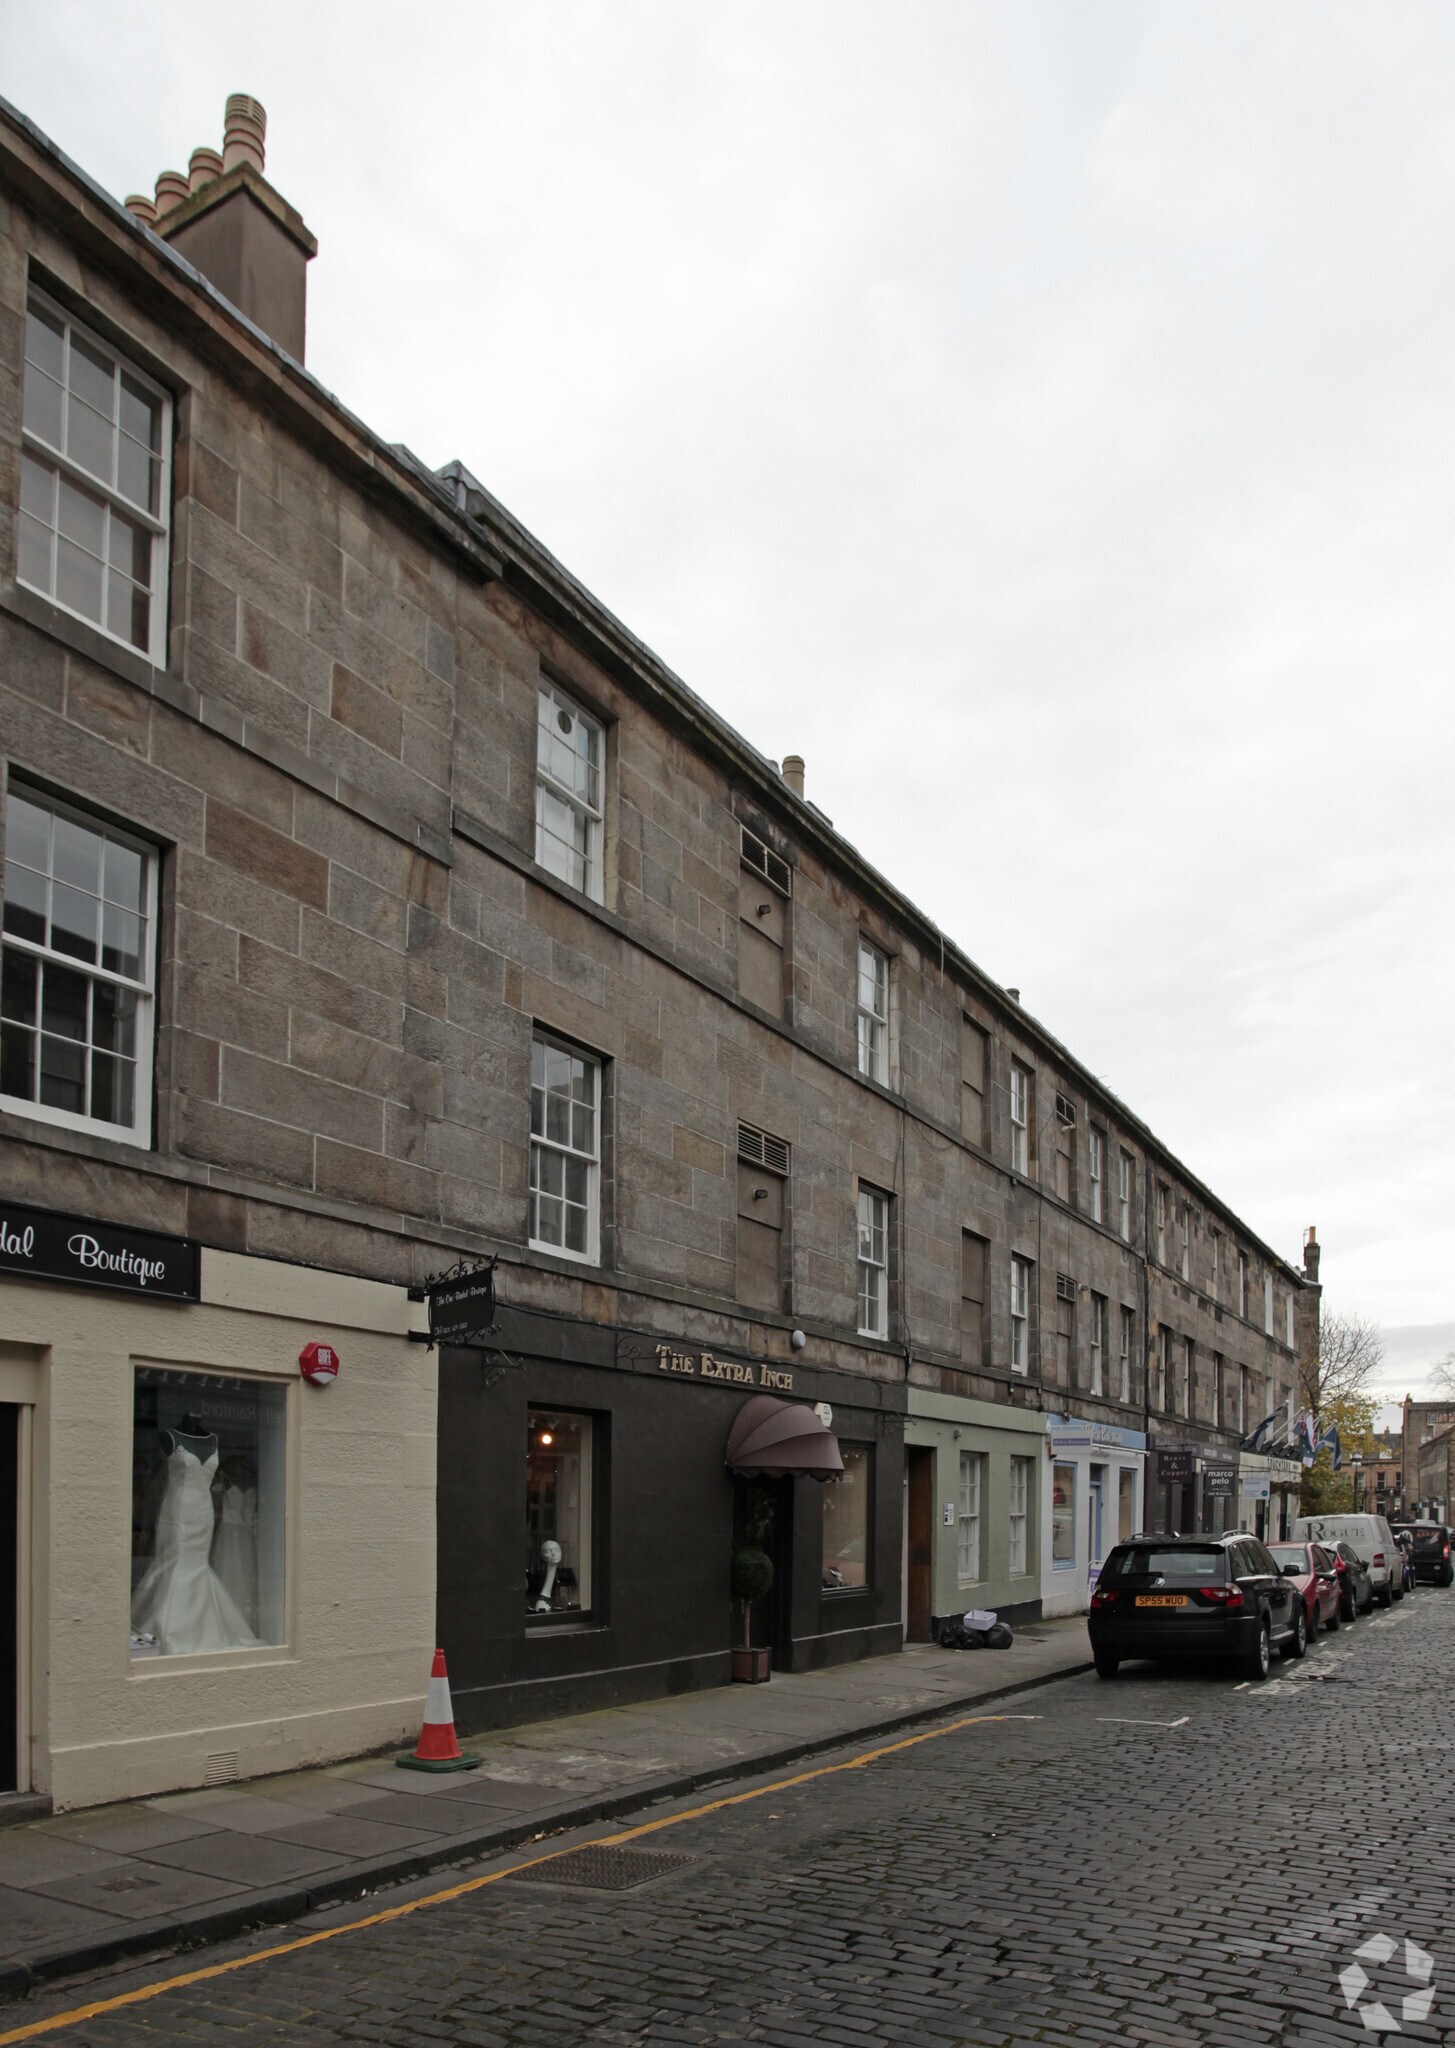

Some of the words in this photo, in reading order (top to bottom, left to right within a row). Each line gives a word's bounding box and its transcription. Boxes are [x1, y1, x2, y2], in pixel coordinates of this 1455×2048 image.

[67, 1234, 165, 1286] Boutique
[656, 1344, 695, 1375] THE
[700, 1352, 755, 1384] EXTRA
[759, 1364, 793, 1390] INCH
[1306, 1522, 1364, 1541] ROGUE
[1139, 1596, 1163, 1605] SP55
